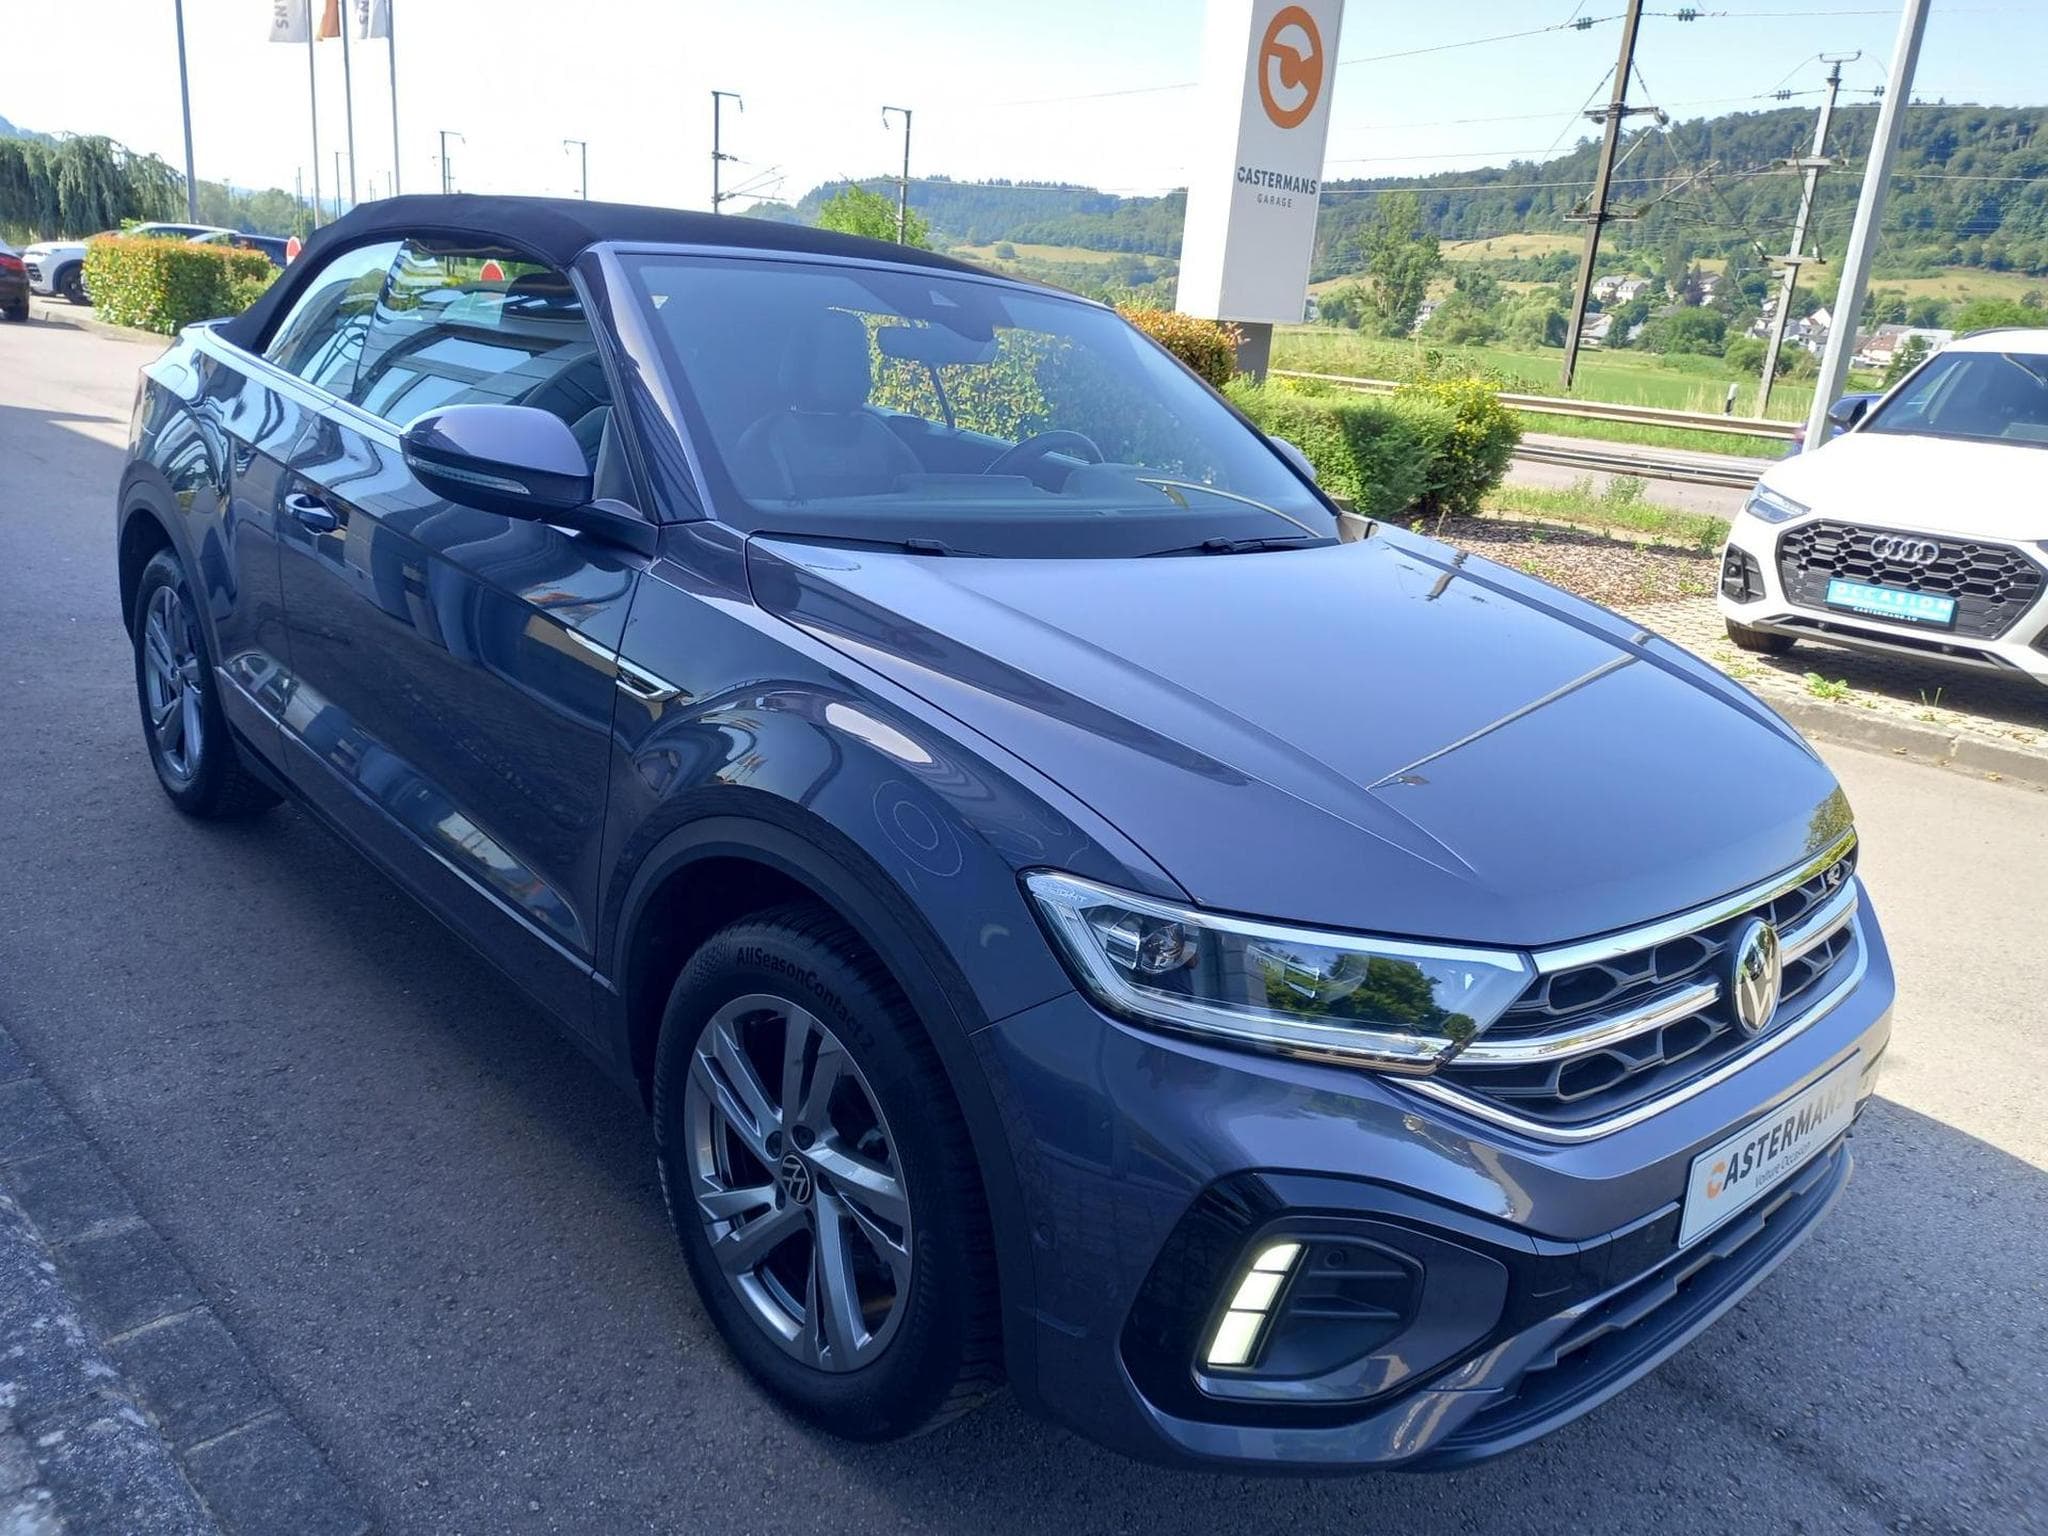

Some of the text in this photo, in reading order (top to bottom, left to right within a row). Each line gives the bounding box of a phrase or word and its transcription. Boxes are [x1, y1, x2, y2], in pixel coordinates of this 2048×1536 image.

[274, 0, 290, 29] NS
[1237, 166, 1318, 195] CASTERMANS
[1257, 193, 1293, 208] GARAGE
[736, 946, 865, 1039] AllSeasonContact
